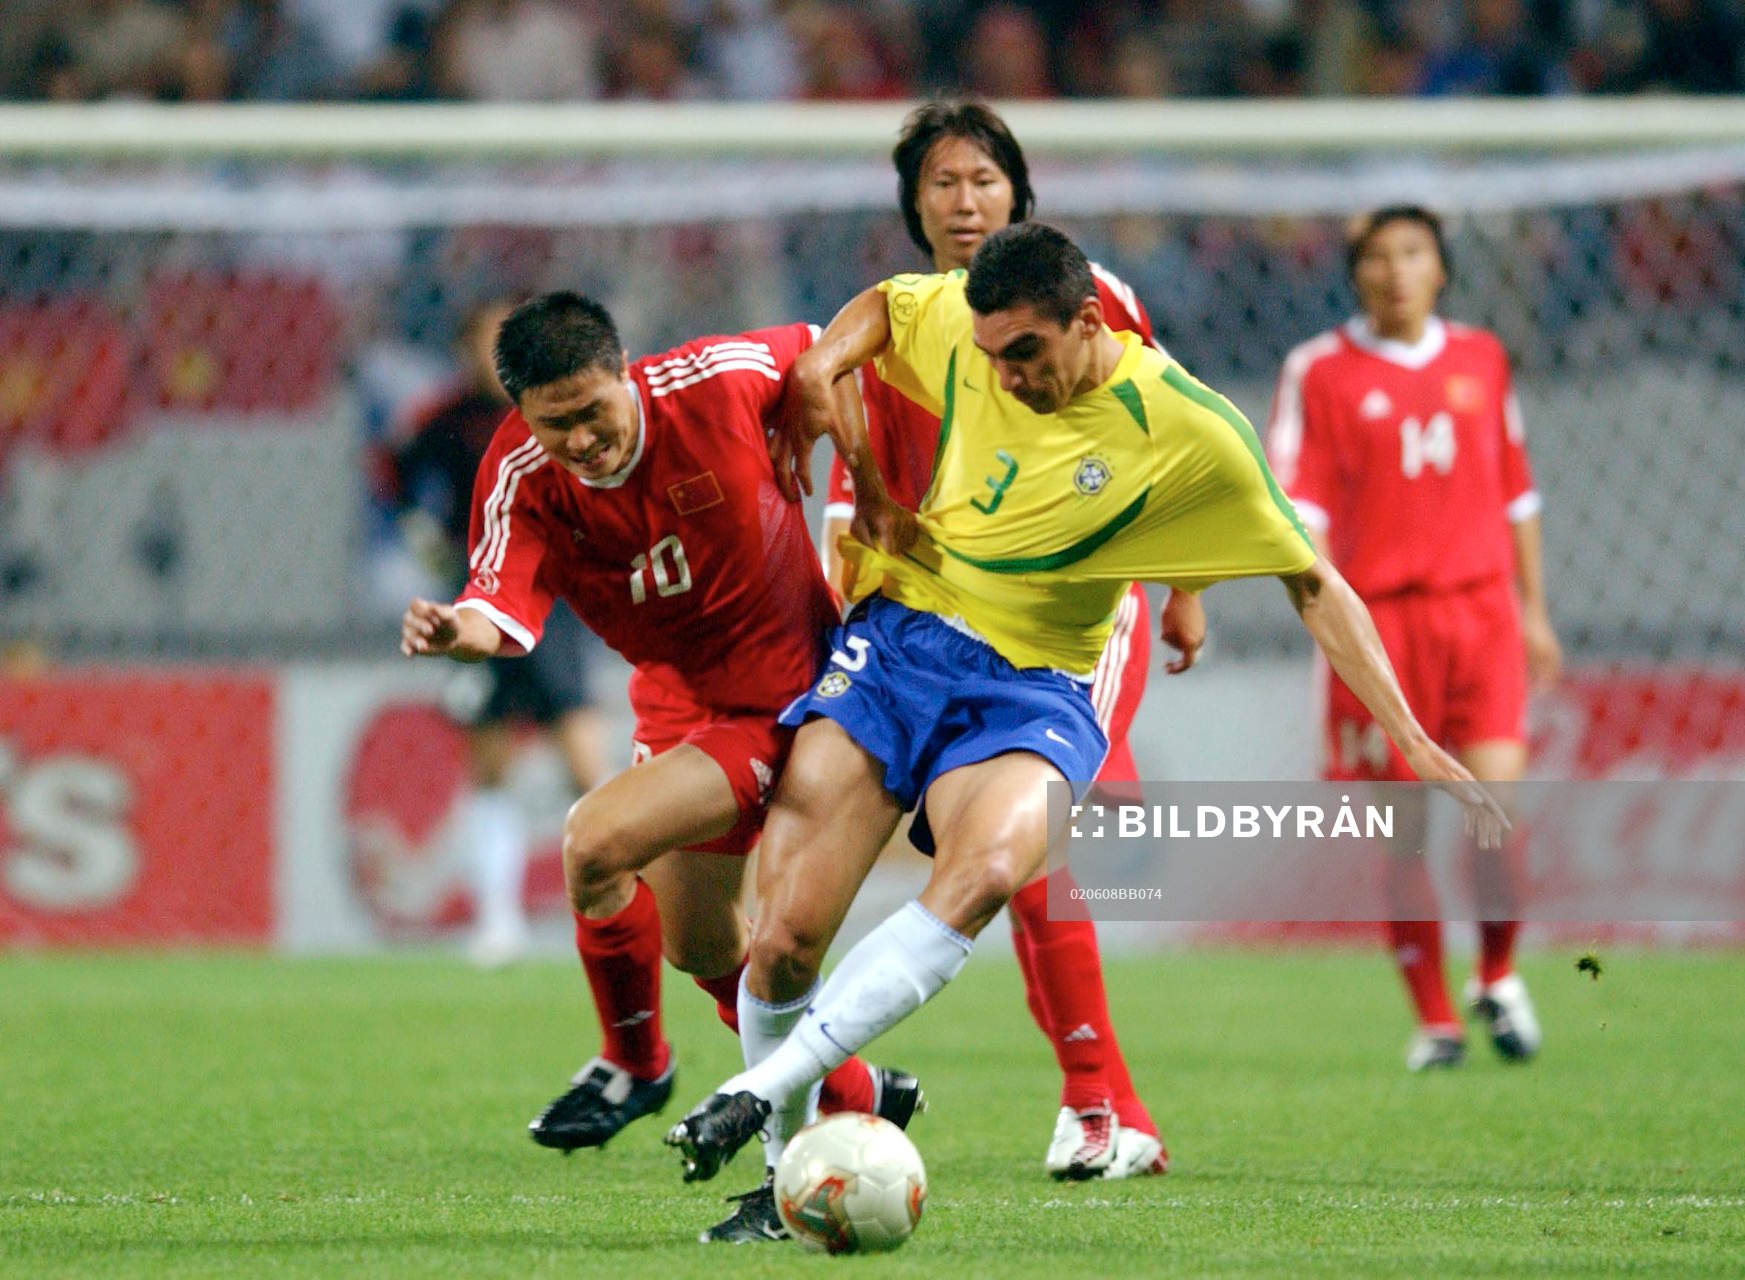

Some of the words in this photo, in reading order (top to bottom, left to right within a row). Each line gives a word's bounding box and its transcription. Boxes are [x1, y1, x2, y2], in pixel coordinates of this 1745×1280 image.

[1400, 412, 1456, 478] 14
[970, 448, 1018, 515] 3
[630, 534, 692, 605] 10
